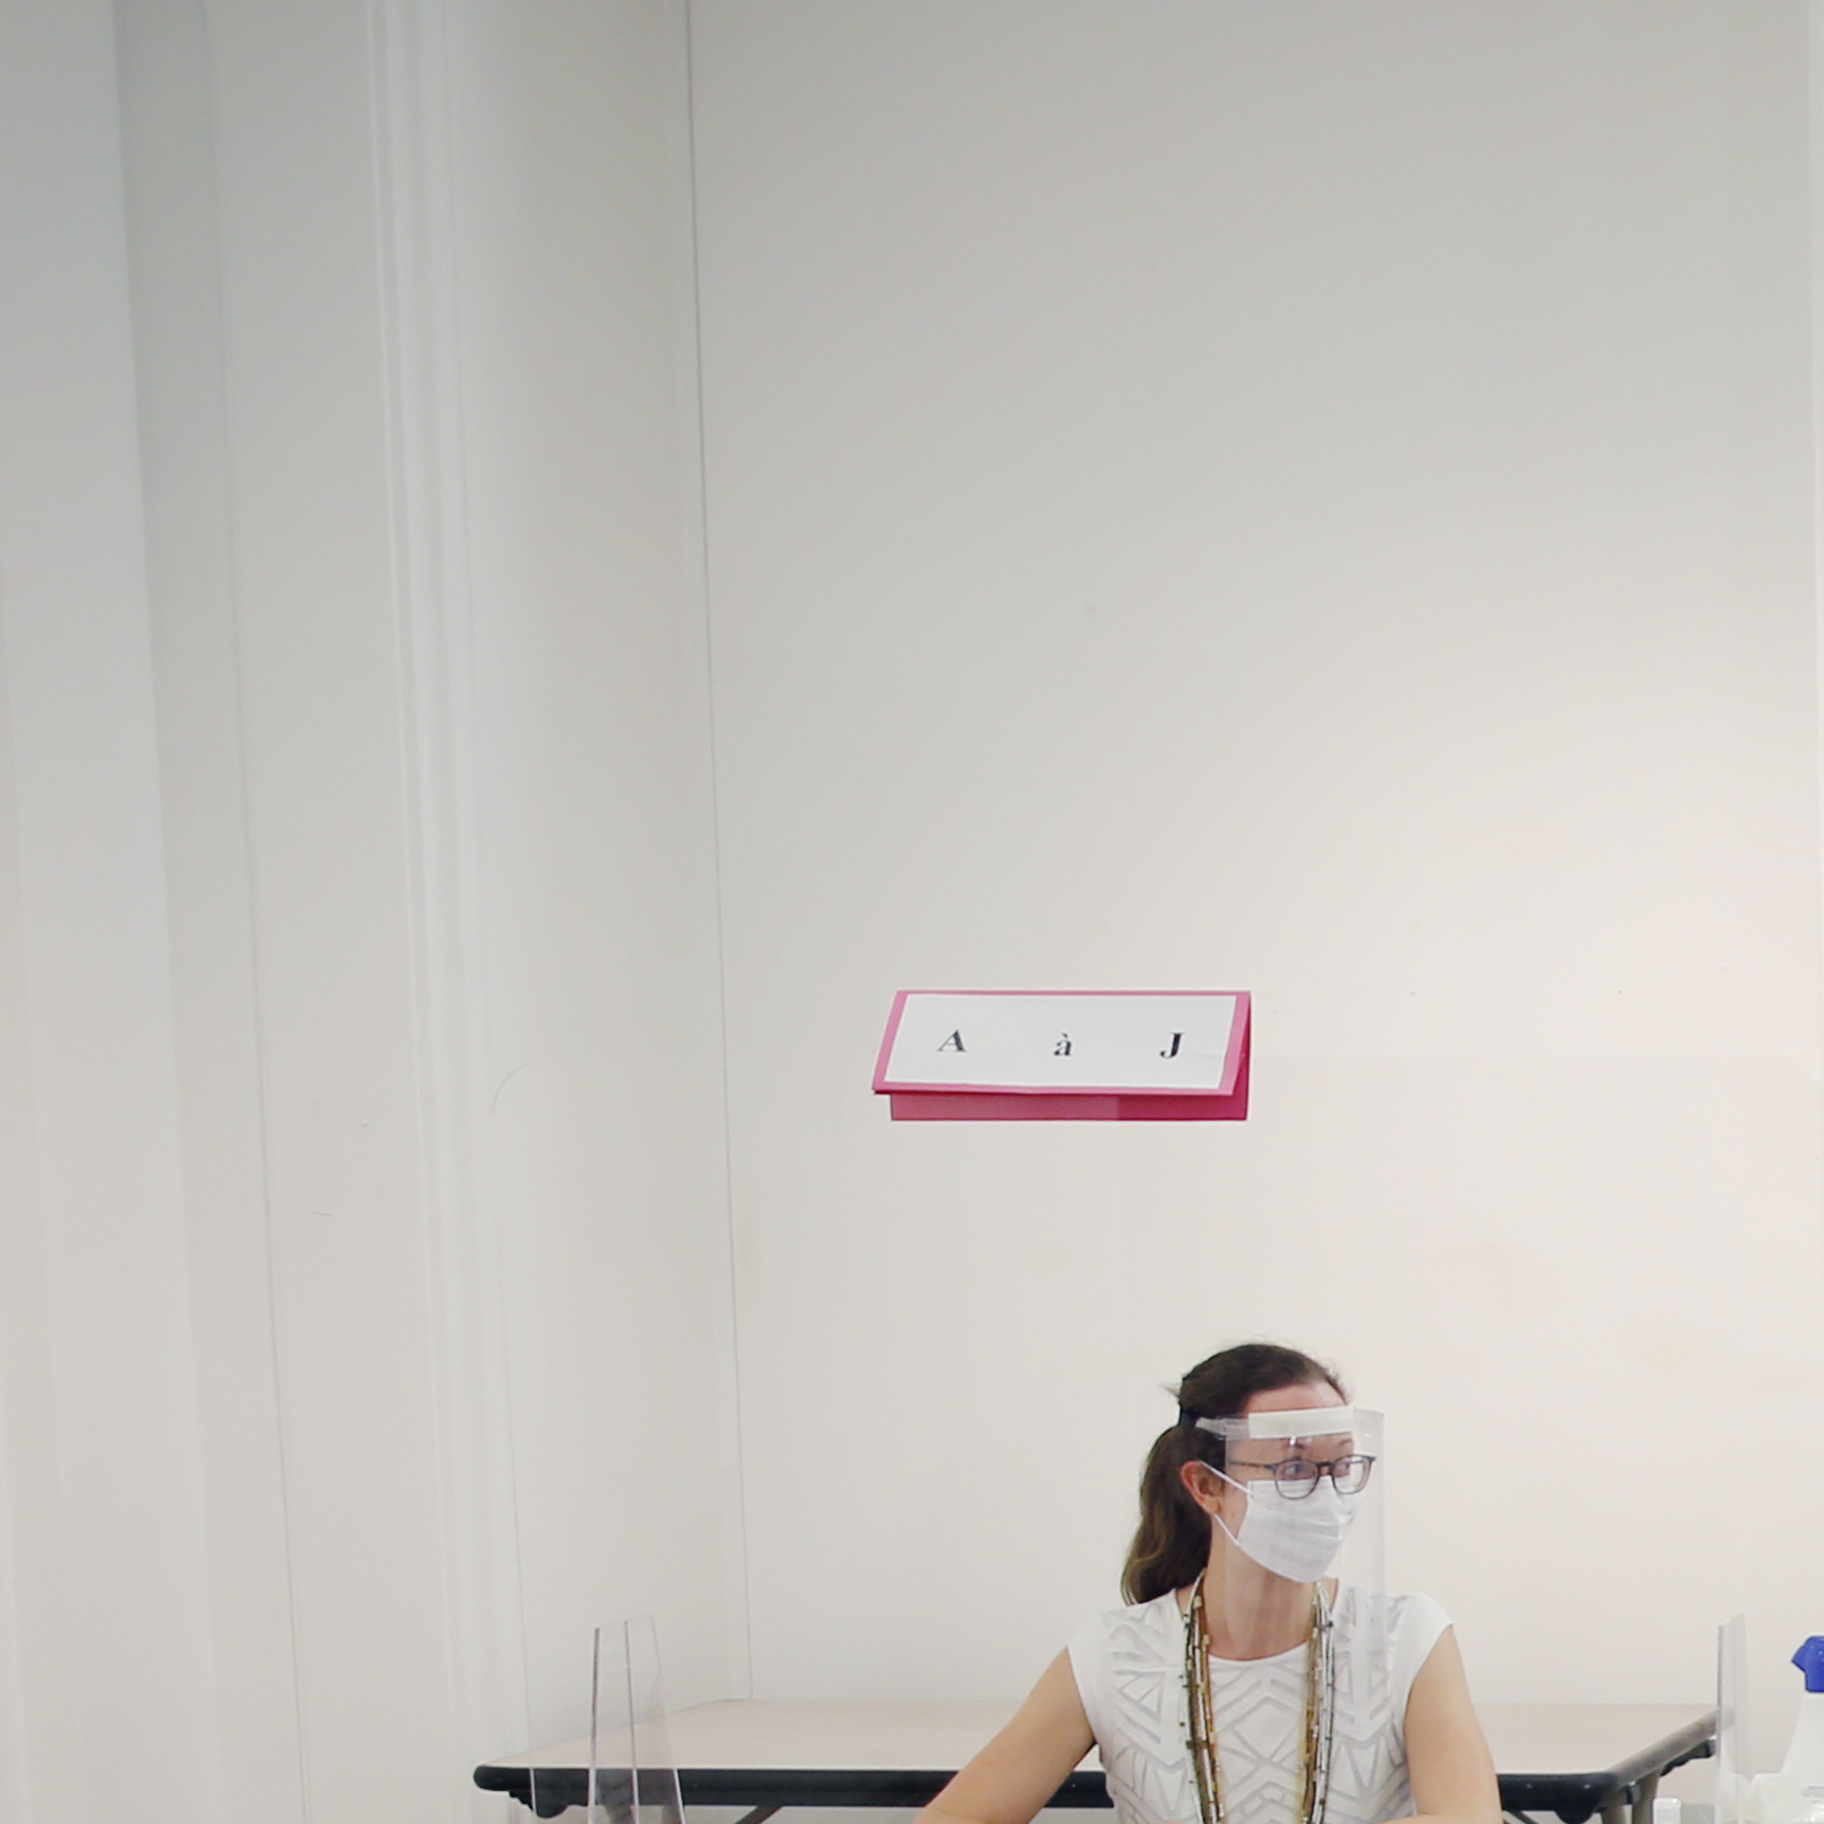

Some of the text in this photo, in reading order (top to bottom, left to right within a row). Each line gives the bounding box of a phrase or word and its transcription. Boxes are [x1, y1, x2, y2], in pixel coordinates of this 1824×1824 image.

[937, 1029, 1186, 1059] A à J
